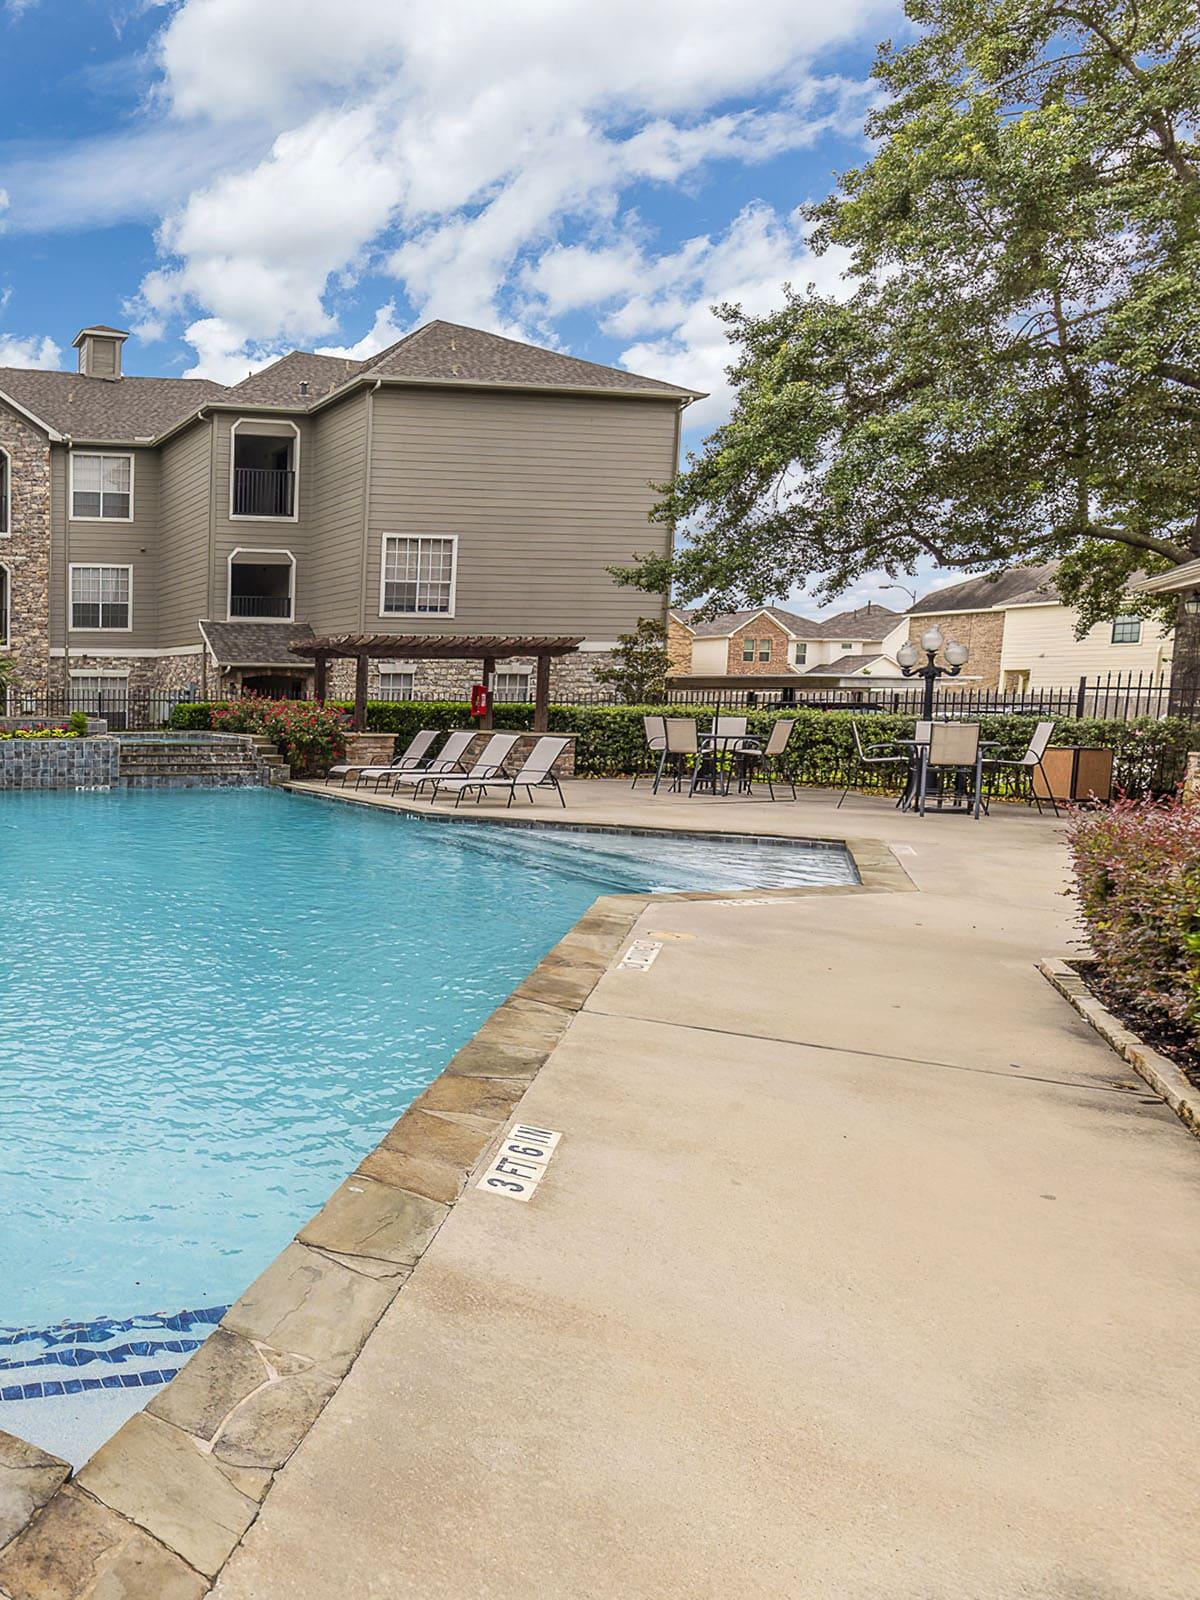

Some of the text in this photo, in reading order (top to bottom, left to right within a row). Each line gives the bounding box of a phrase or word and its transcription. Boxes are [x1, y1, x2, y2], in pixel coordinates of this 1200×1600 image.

[507, 1144, 544, 1157] 6
[495, 1156, 537, 1179] FT
[486, 1177, 525, 1193] 3
